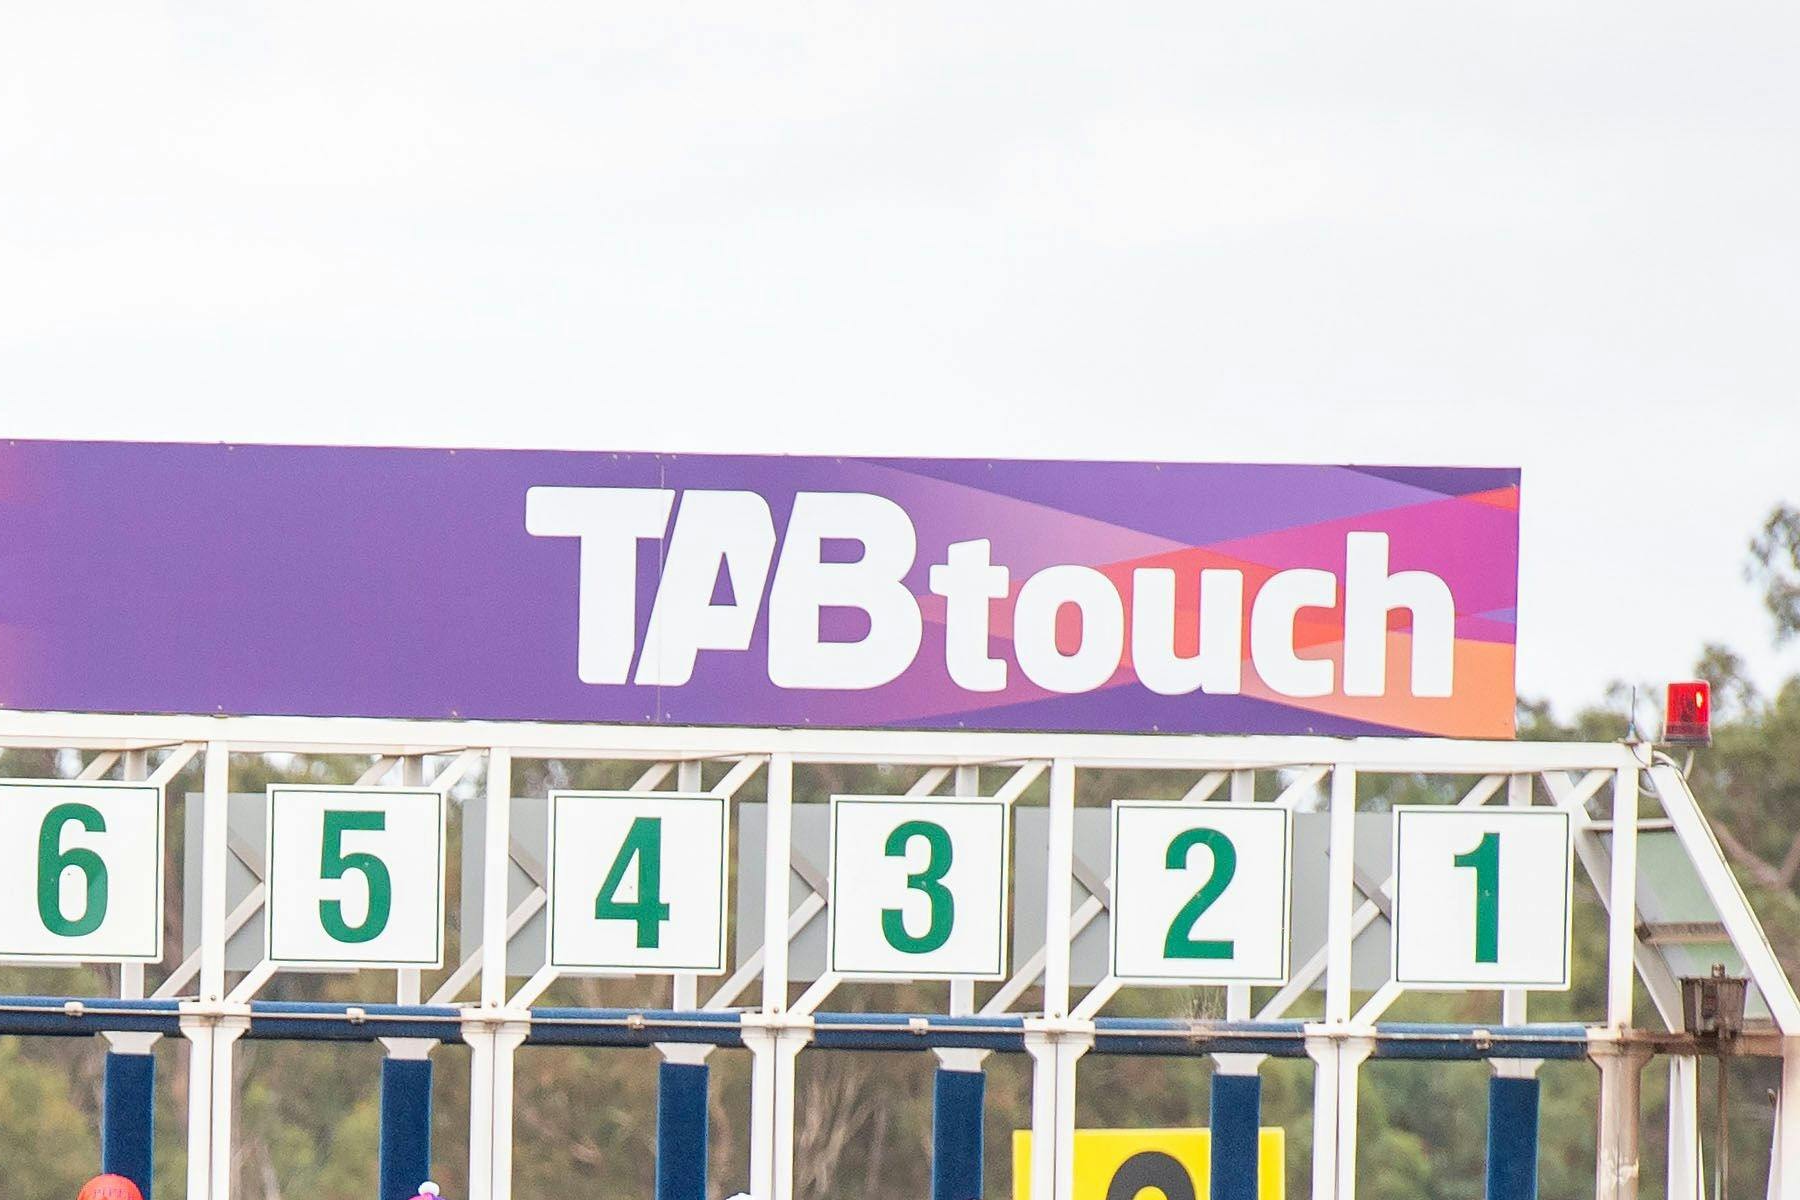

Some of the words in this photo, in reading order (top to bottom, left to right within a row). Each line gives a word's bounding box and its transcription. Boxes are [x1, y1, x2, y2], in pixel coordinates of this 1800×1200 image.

[525, 485, 1455, 701] TABtouch
[37, 803, 108, 937] 6
[319, 810, 391, 944] 5
[595, 817, 669, 949] 4
[882, 820, 954, 954] 3
[1163, 828, 1234, 960] 2
[1453, 833, 1500, 964] 1
